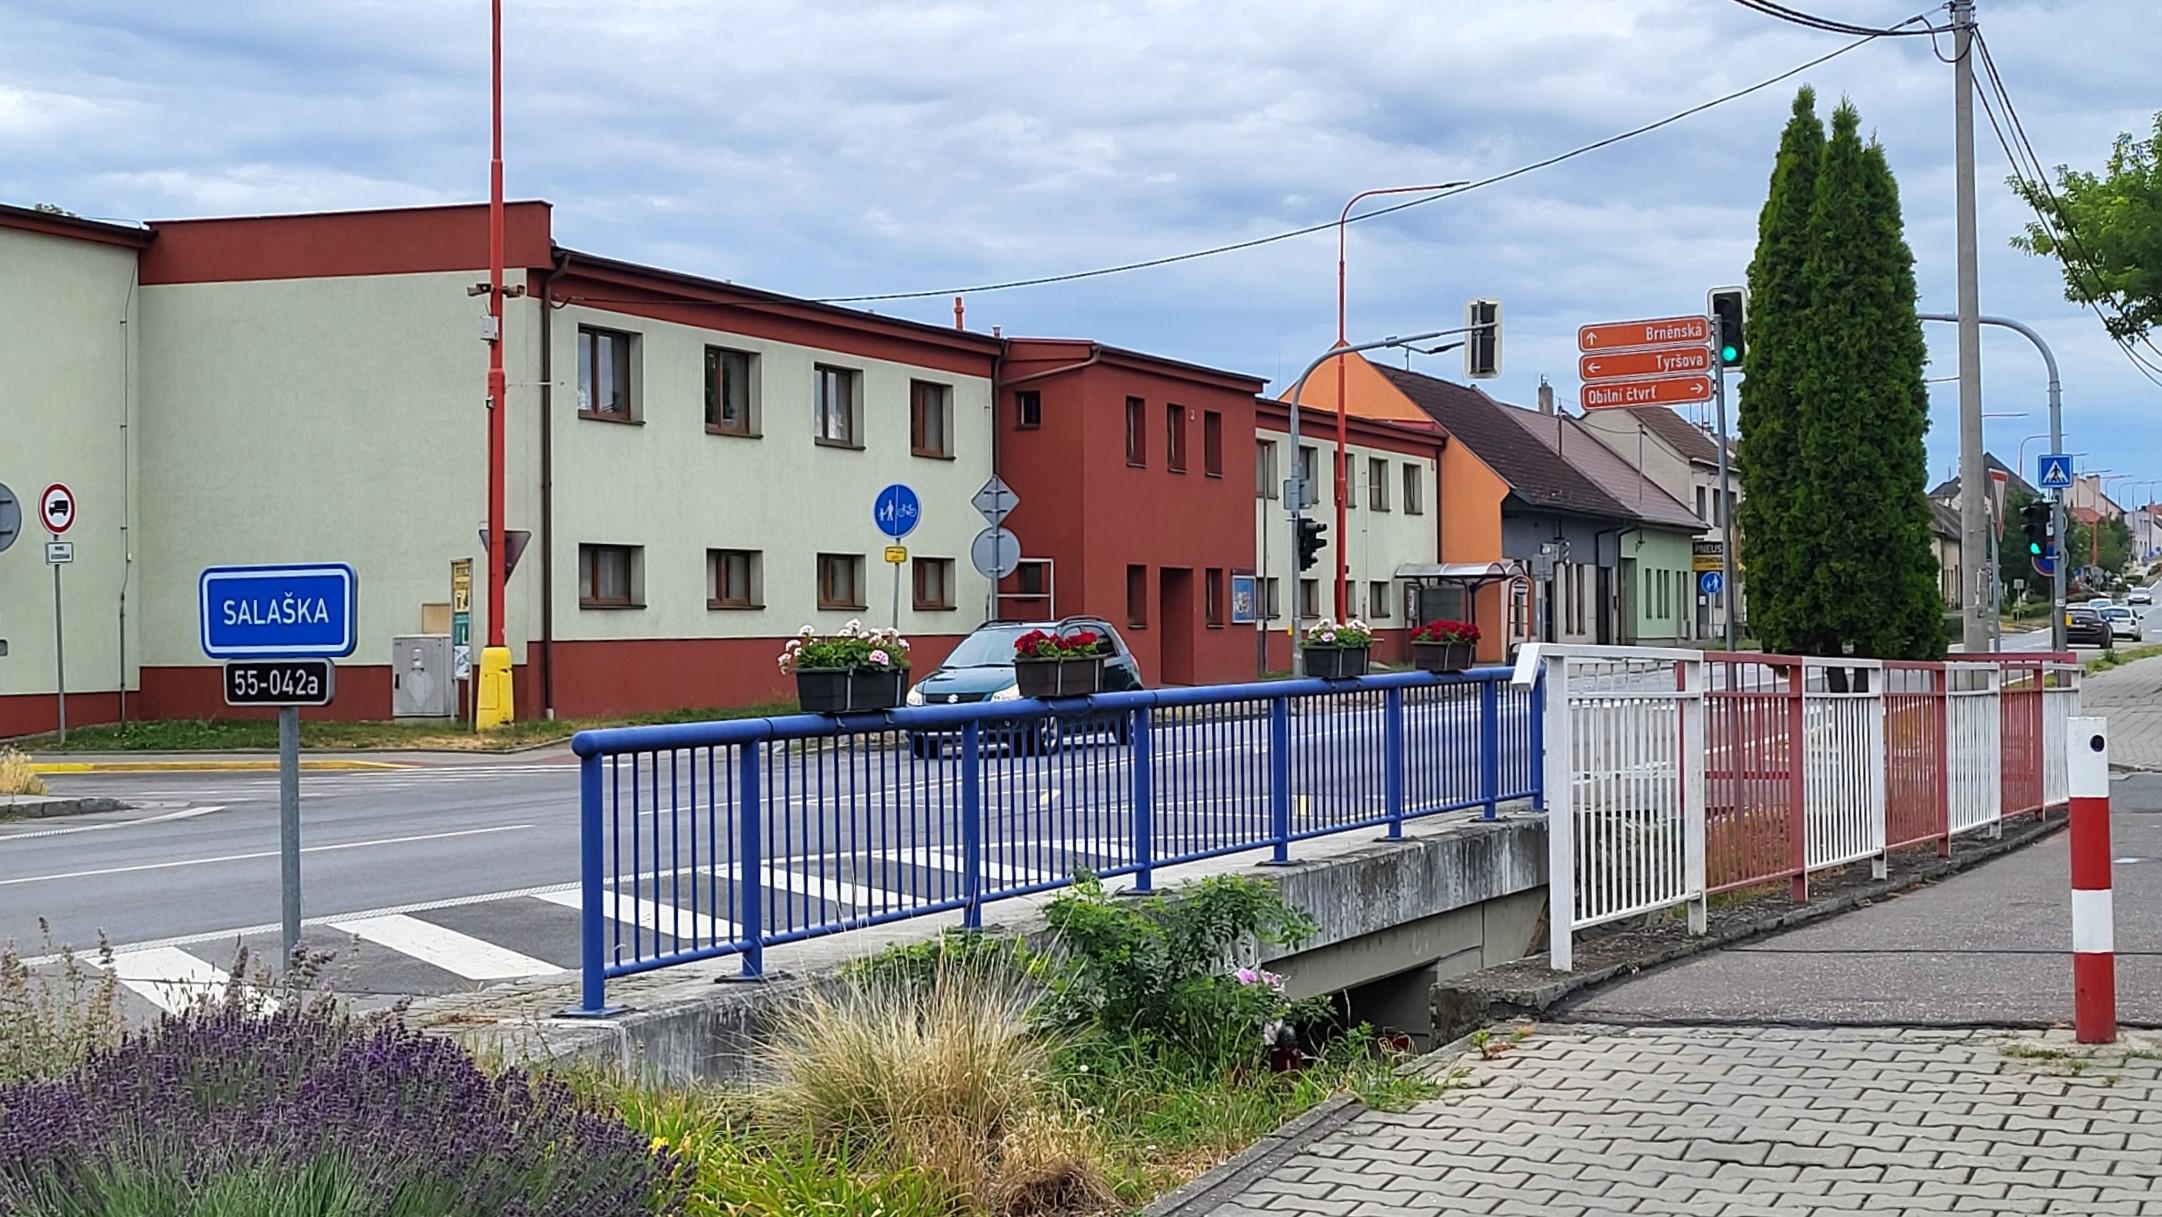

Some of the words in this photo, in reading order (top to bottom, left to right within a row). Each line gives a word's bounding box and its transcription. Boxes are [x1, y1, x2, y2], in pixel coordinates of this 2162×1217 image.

[1646, 323, 1702, 341] Brněnská
[1656, 355, 1703, 373] Tyršova
[1589, 388, 1623, 404] Obilní
[223, 591, 329, 625] SALAŠKA
[234, 669, 319, 695] 55-042a
